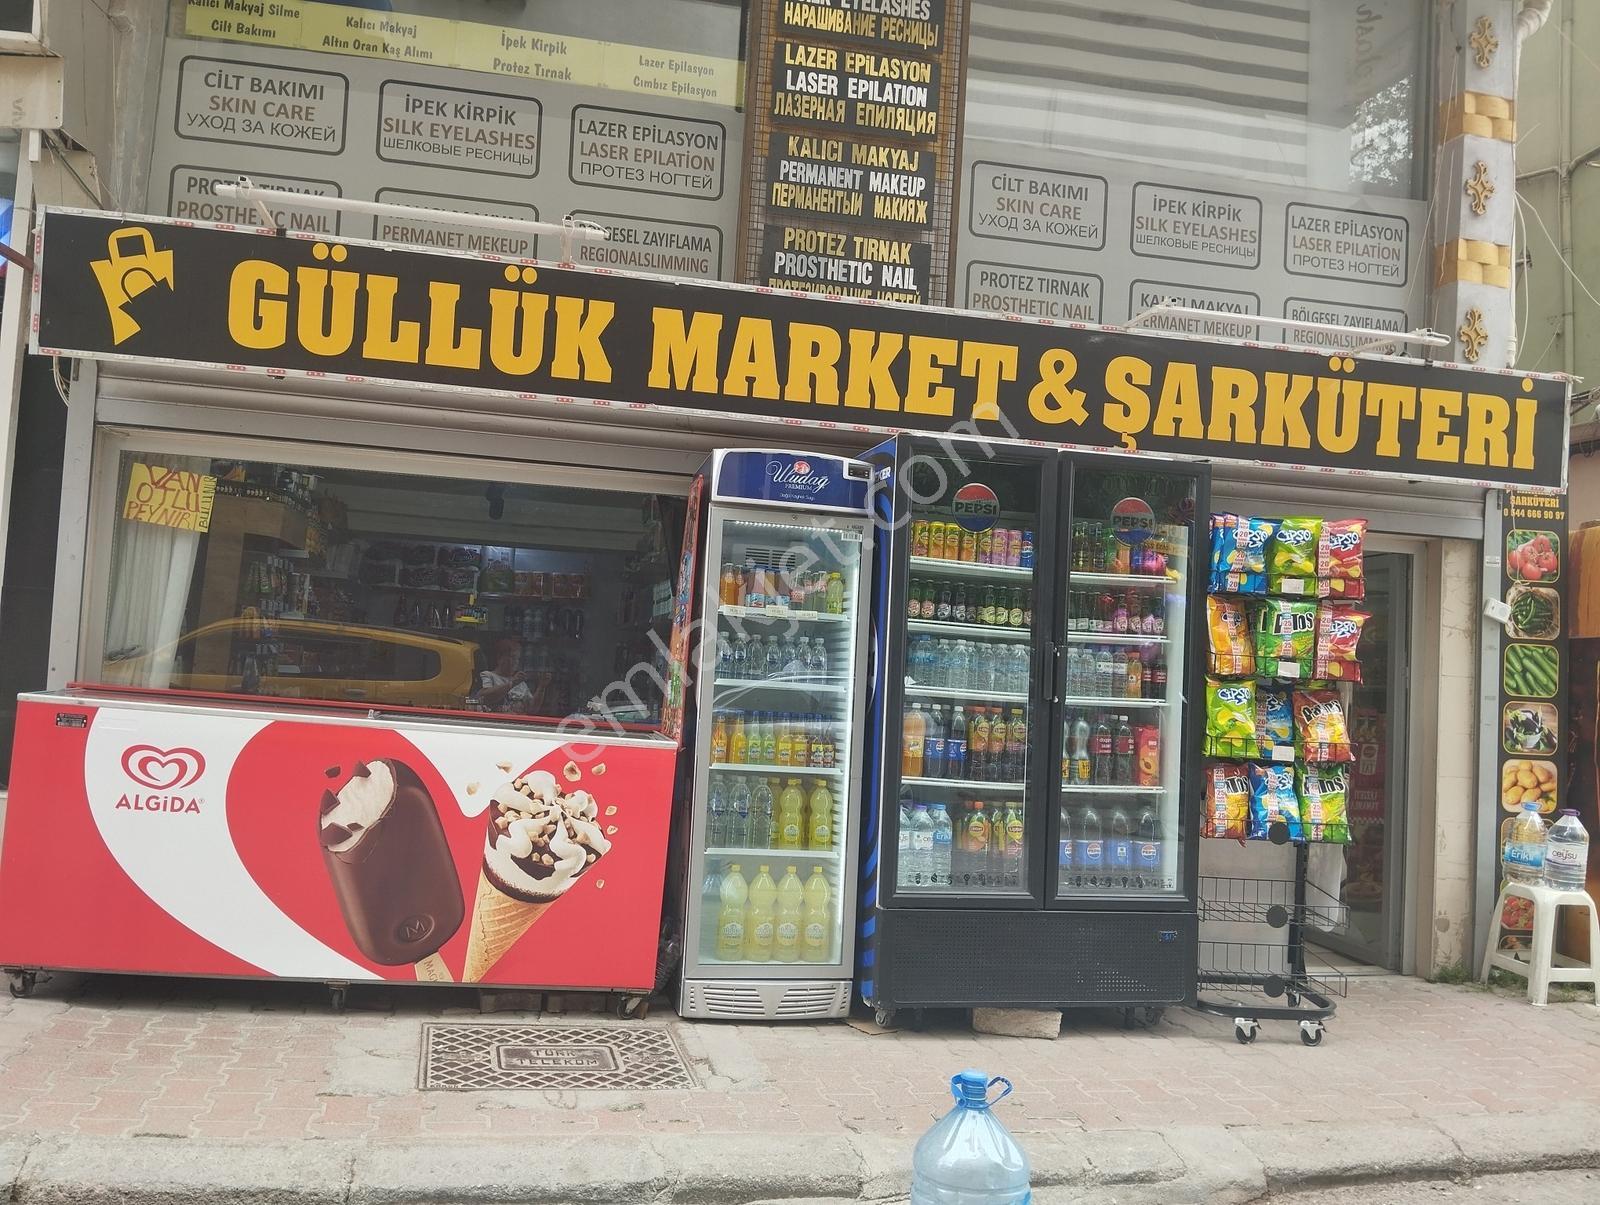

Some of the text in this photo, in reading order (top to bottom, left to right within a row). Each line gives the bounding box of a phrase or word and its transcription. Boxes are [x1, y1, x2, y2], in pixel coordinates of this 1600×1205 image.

[268, 3, 300, 19] Silme
[211, 19, 276, 38] Cilt Bakımı
[346, 16, 417, 38] Kalıcı Makyaj
[784, 1, 940, 50] НАРАШИВАНИЕ РЕСНИЦЫ
[322, 35, 433, 60] Altın Oran Kaş Alımı
[531, 36, 567, 56] Kirpik
[785, 43, 837, 73] LAZER
[492, 57, 572, 82] Protez Tırnak
[639, 54, 715, 78] Lazer Epilasyon
[204, 69, 324, 101] CİLT BAKIMI
[633, 75, 718, 100] Cımbız Epilasyon
[786, 69, 928, 108] LASER EPILATION
[208, 95, 316, 122] SKIN CARE
[404, 94, 516, 126] İPEK KİRPİK
[773, 91, 937, 137] ЛАЗЕРНАЯ ЕПИЛЯЦИЯ
[187, 112, 336, 143] УХОД ЗА КОЖЕЙ
[383, 117, 536, 150] SILK EYELASHES
[579, 119, 719, 151] LAZER EPİLASYON
[384, 137, 533, 166] ШЕЛКОВЫЕ РЕСНИЦЫ
[580, 141, 629, 161] LASER
[788, 135, 919, 172] KALICI MAKYAJ
[580, 162, 712, 190] ПРОТЕЗ НОГТЕЙ
[779, 159, 926, 199] PERMANENT MAKEUP
[991, 172, 1089, 202] CİLT BAKIMI
[874, 194, 929, 225] МАКИЯЖ
[996, 196, 1082, 221] SKIN CARE
[1152, 193, 1242, 222] İPEK KİRPİK
[290, 212, 331, 233] NAIL
[978, 212, 1098, 240] УХОД ЗА КОЖЕЙ
[1135, 215, 1257, 244] SILK EYELASHES
[1291, 215, 1404, 243] LAZER EPİLASYON
[383, 224, 529, 255] PERMANET MEKEUP
[643, 230, 712, 253] ZAYIFLAMA
[783, 227, 912, 265] PROTEZ TIRNAK
[1135, 234, 1256, 258] ШЕЛКОВЫЕ РЕСНИЦЫ
[1292, 235, 1332, 253] LASER
[580, 245, 709, 274] REGIONALSLIMMING
[774, 251, 918, 291] PROSTHETIC NAIL
[1293, 254, 1400, 279] ПРОТЕЗ НОГТЕЙ
[980, 271, 1090, 299] PROTEZ TIRNAK
[972, 293, 1095, 322] PROSTHETIC NAIL
[1203, 321, 1252, 338] MEKEUP
[226, 243, 1539, 472] GÜLLÜK MARKET & ŞARKÜTERİ
[145, 463, 200, 493] VAN
[766, 460, 830, 493] Uludağ
[954, 501, 998, 516] PEPSI
[1112, 516, 1153, 528] PEPSI
[1544, 511, 1553, 520] 90
